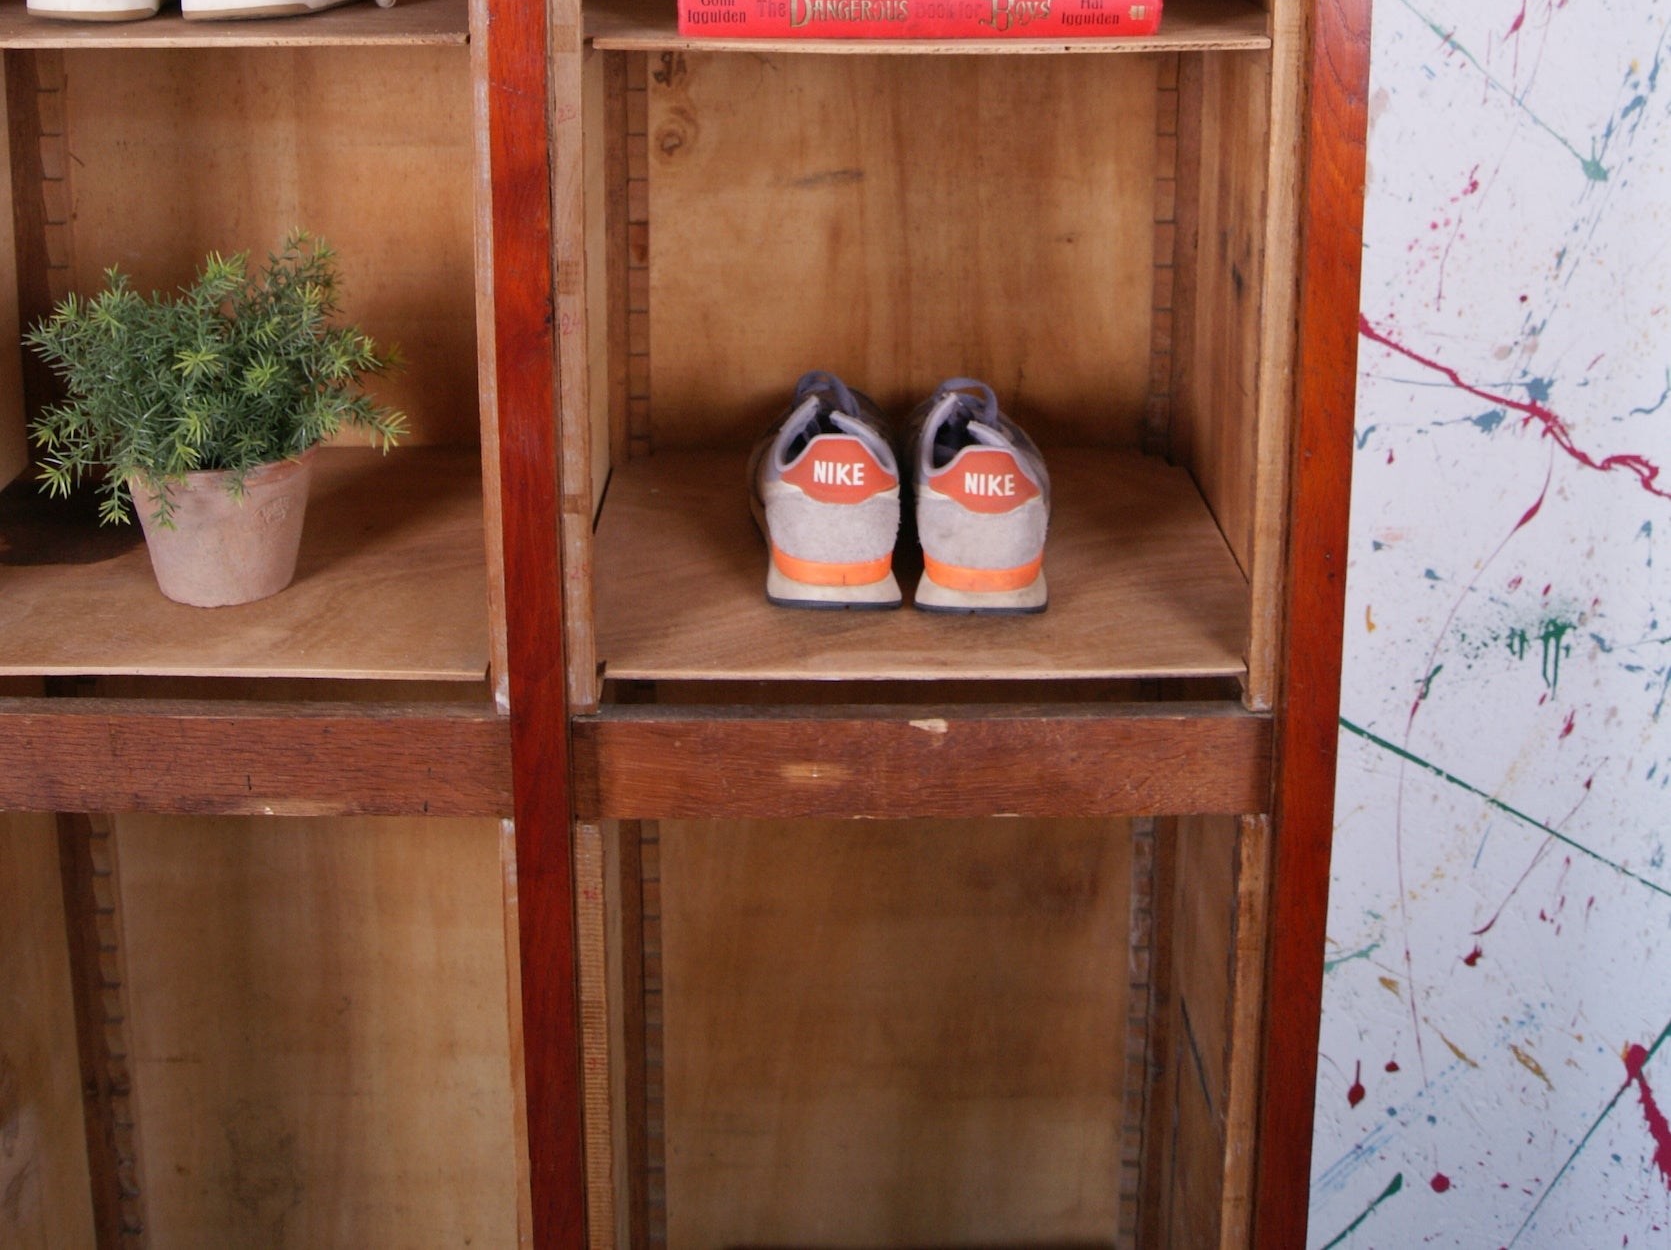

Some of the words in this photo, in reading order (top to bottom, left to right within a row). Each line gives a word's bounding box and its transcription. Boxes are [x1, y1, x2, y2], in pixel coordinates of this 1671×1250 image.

[688, 9, 746, 24] Iggulden
[1061, 12, 1120, 26] Iggulden
[813, 461, 865, 486] NIKE
[964, 473, 1015, 496] NIKE
